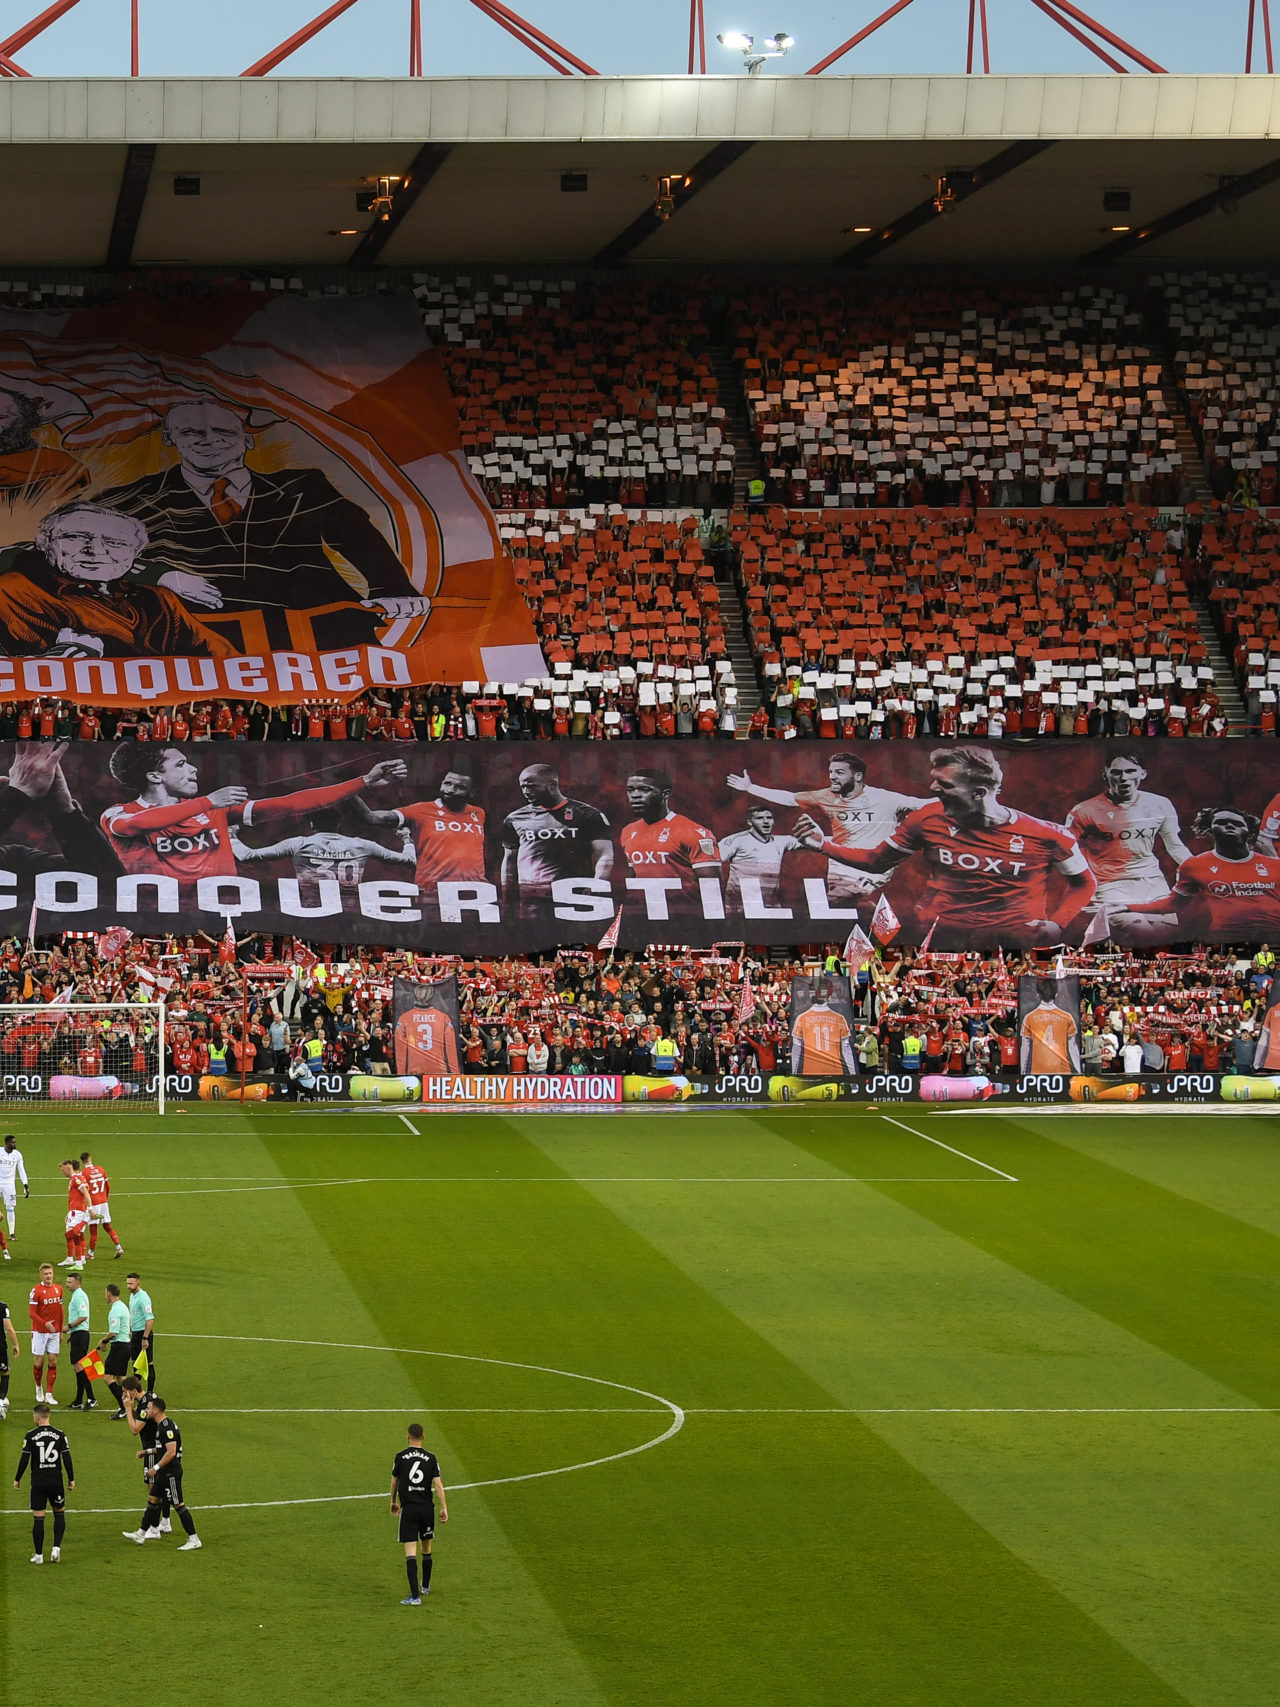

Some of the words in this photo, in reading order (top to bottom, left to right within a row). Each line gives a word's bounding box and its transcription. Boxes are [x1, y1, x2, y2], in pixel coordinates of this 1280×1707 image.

[434, 820, 483, 836] BOXT
[525, 827, 580, 841] BOXT
[1105, 825, 1158, 841] BOXT
[157, 829, 220, 855] BOXT
[314, 849, 352, 860] SAMBA
[939, 848, 1026, 877] BOXT
[309, 857, 360, 885] 30
[1232, 880, 1276, 891] Football
[1234, 888, 1266, 898] Index
[552, 877, 858, 921] STILL
[412, 1013, 437, 1022] PEARCE
[1182, 1014, 1208, 1022] PSYCHO
[417, 1023, 433, 1050] 3
[528, 1027, 541, 1037] 23
[813, 1027, 830, 1051] 11
[1041, 1024, 1057, 1049] 4
[428, 1077, 509, 1100] HEALTHY
[513, 1077, 617, 1100] HYDRATION
[90, 1179, 106, 1195] 37
[32, 1430, 60, 1441] NORWOOD
[36, 1441, 59, 1463] 16
[402, 1450, 430, 1462] BASHAM
[408, 1461, 425, 1485] 6
